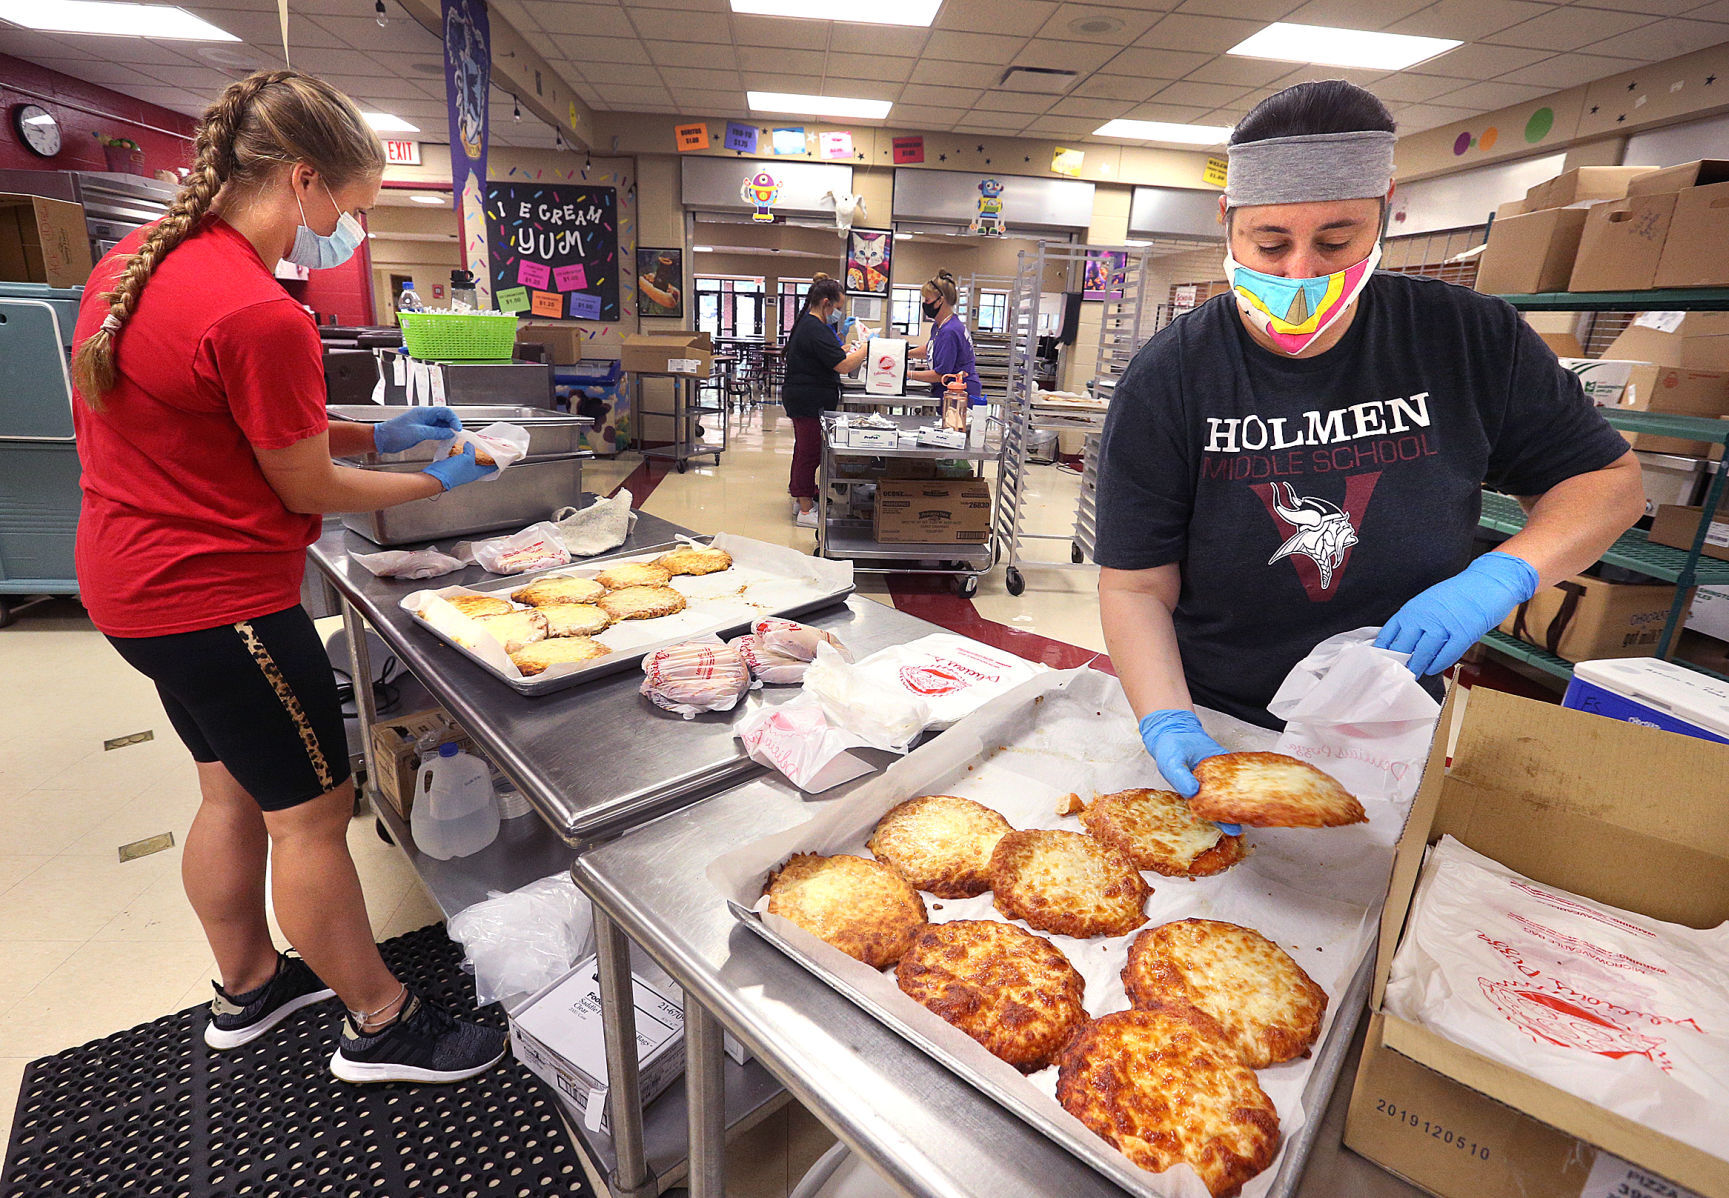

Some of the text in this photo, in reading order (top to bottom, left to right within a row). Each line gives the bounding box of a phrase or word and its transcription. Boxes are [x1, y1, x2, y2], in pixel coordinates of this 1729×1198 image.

[388, 141, 412, 160] EXIT
[538, 204, 602, 226] CREAM
[518, 227, 585, 259] YUM
[1204, 391, 1431, 453] HOLMEN
[1202, 433, 1439, 481] MIDDLE SCHOOL
[1475, 928, 1541, 977] Pizza
[573, 1002, 589, 1014] Clear
[1547, 977, 1708, 1034] Delicious
[1376, 1098, 1490, 1160] 2019120510
